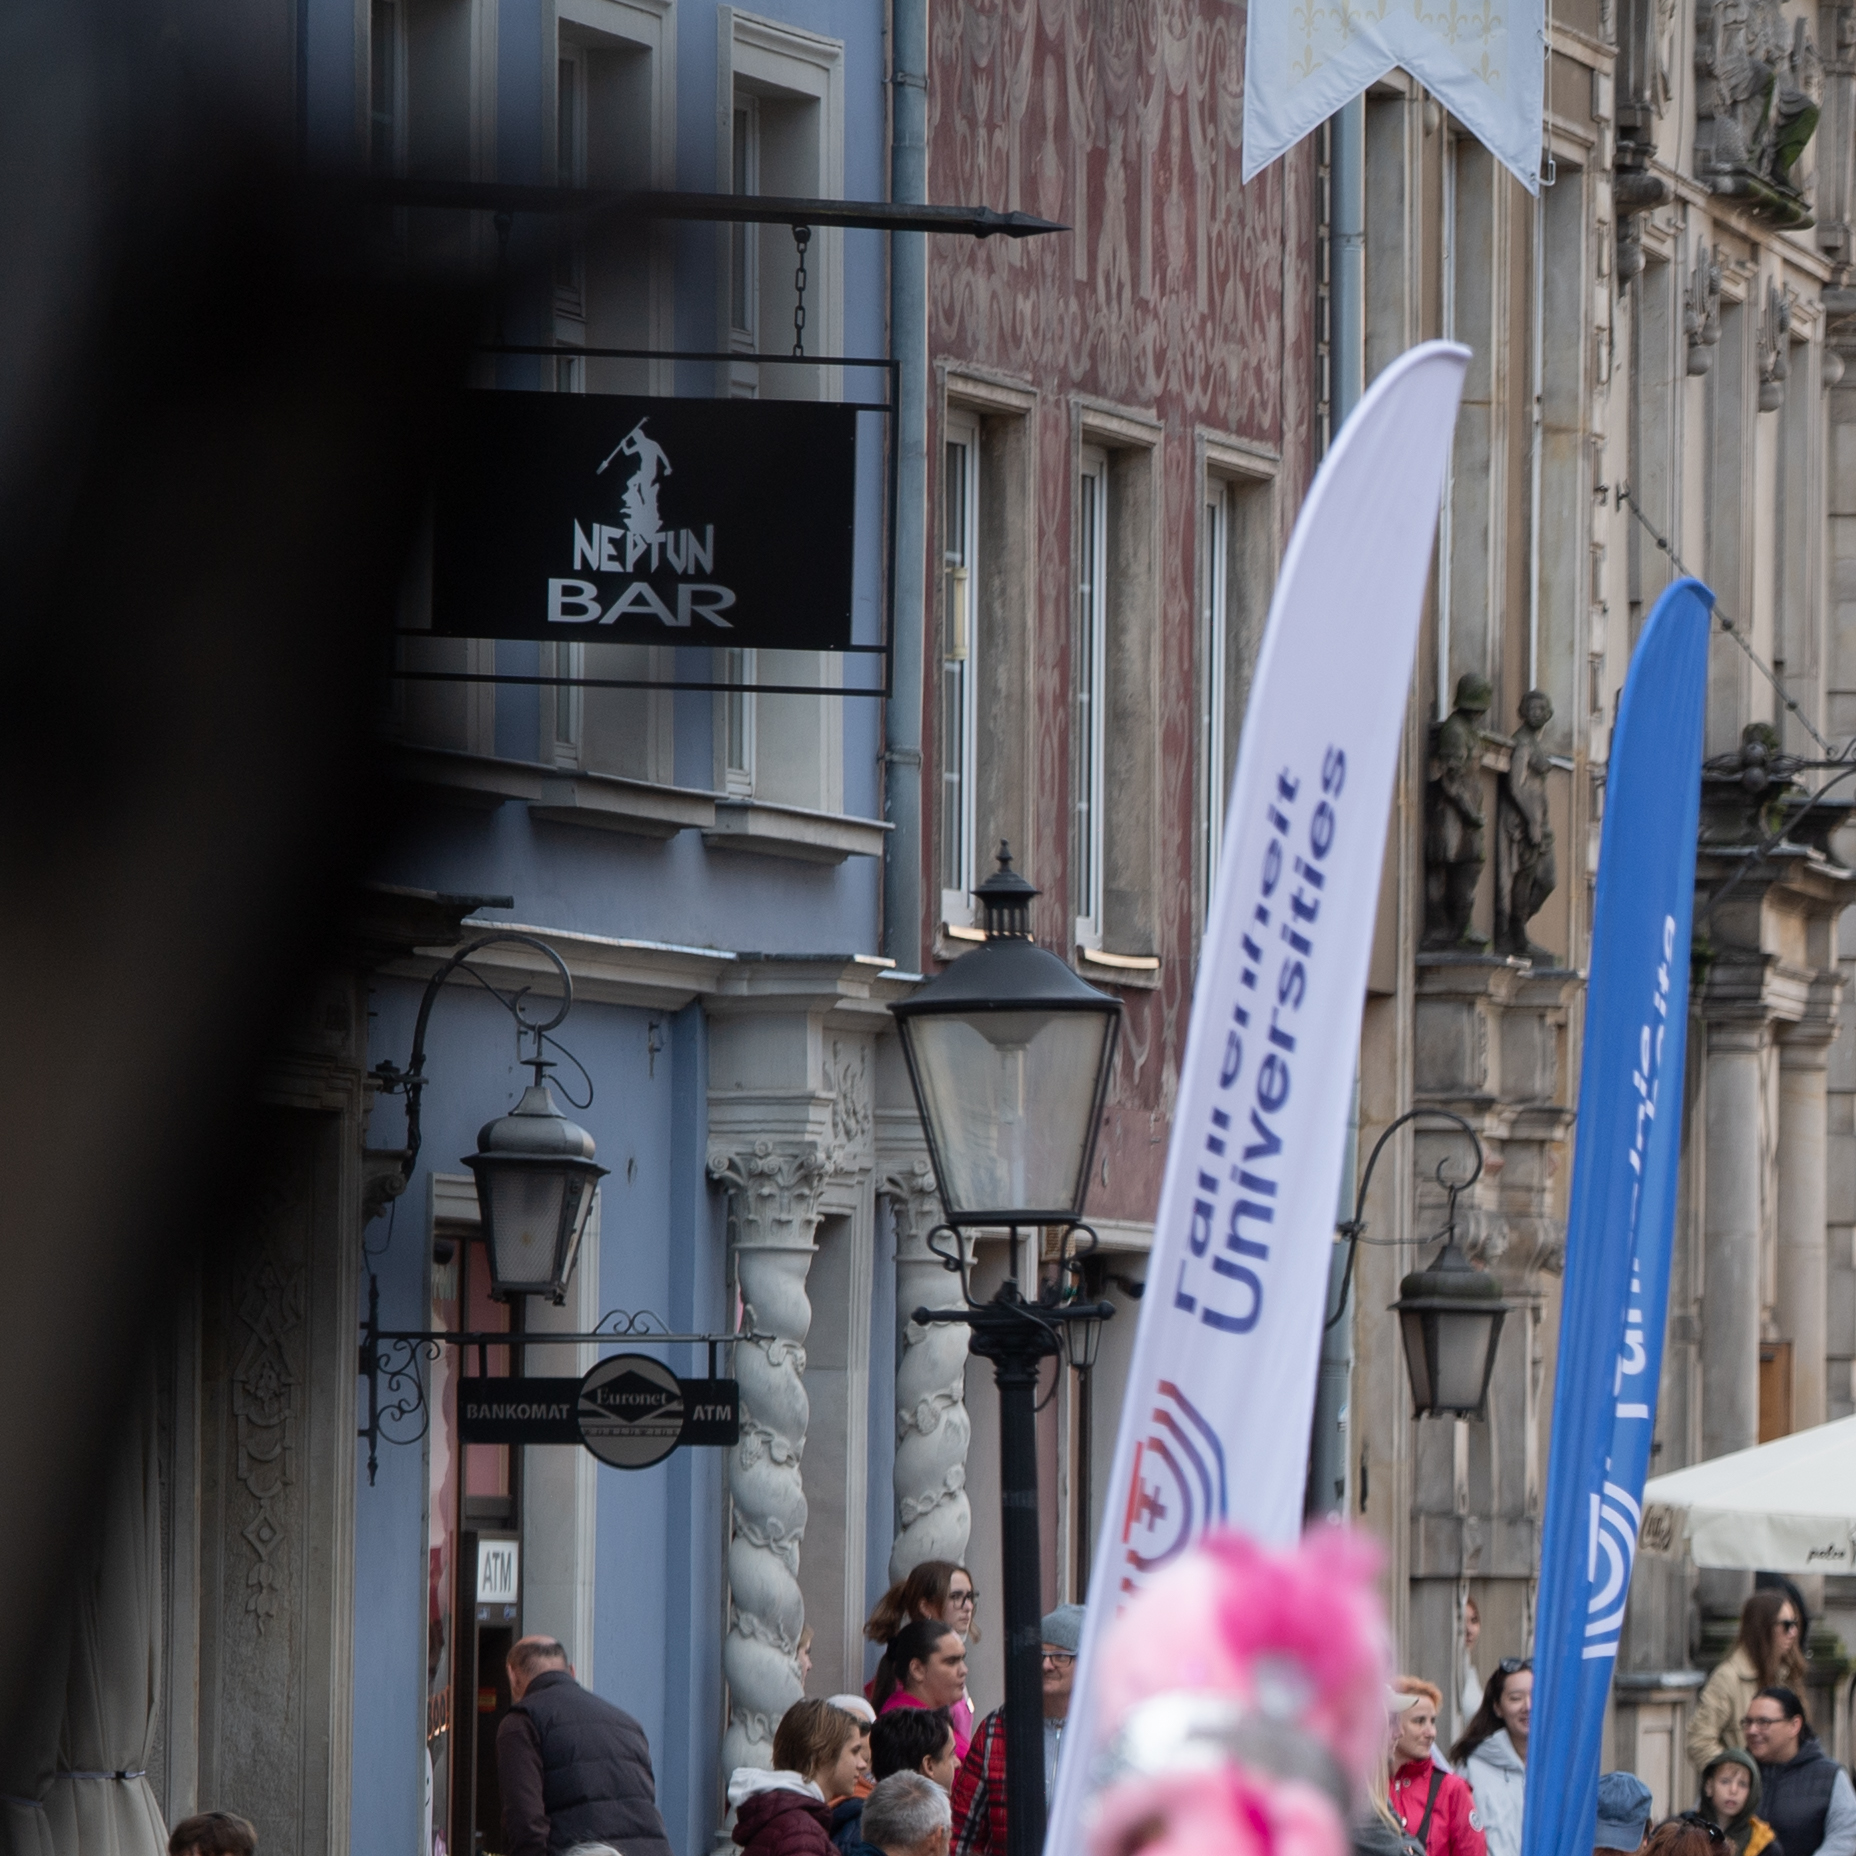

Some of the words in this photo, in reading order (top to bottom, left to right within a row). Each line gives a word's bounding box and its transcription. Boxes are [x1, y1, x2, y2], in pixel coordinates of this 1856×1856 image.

[573, 517, 714, 576] NEPTUN
[547, 578, 736, 628] BAR
[1201, 742, 1349, 1337] Universities
[466, 1403, 571, 1420] BANKOMAT
[597, 1386, 669, 1406] Euronet
[692, 1404, 732, 1422] ATM
[482, 1551, 512, 1593] ATM
